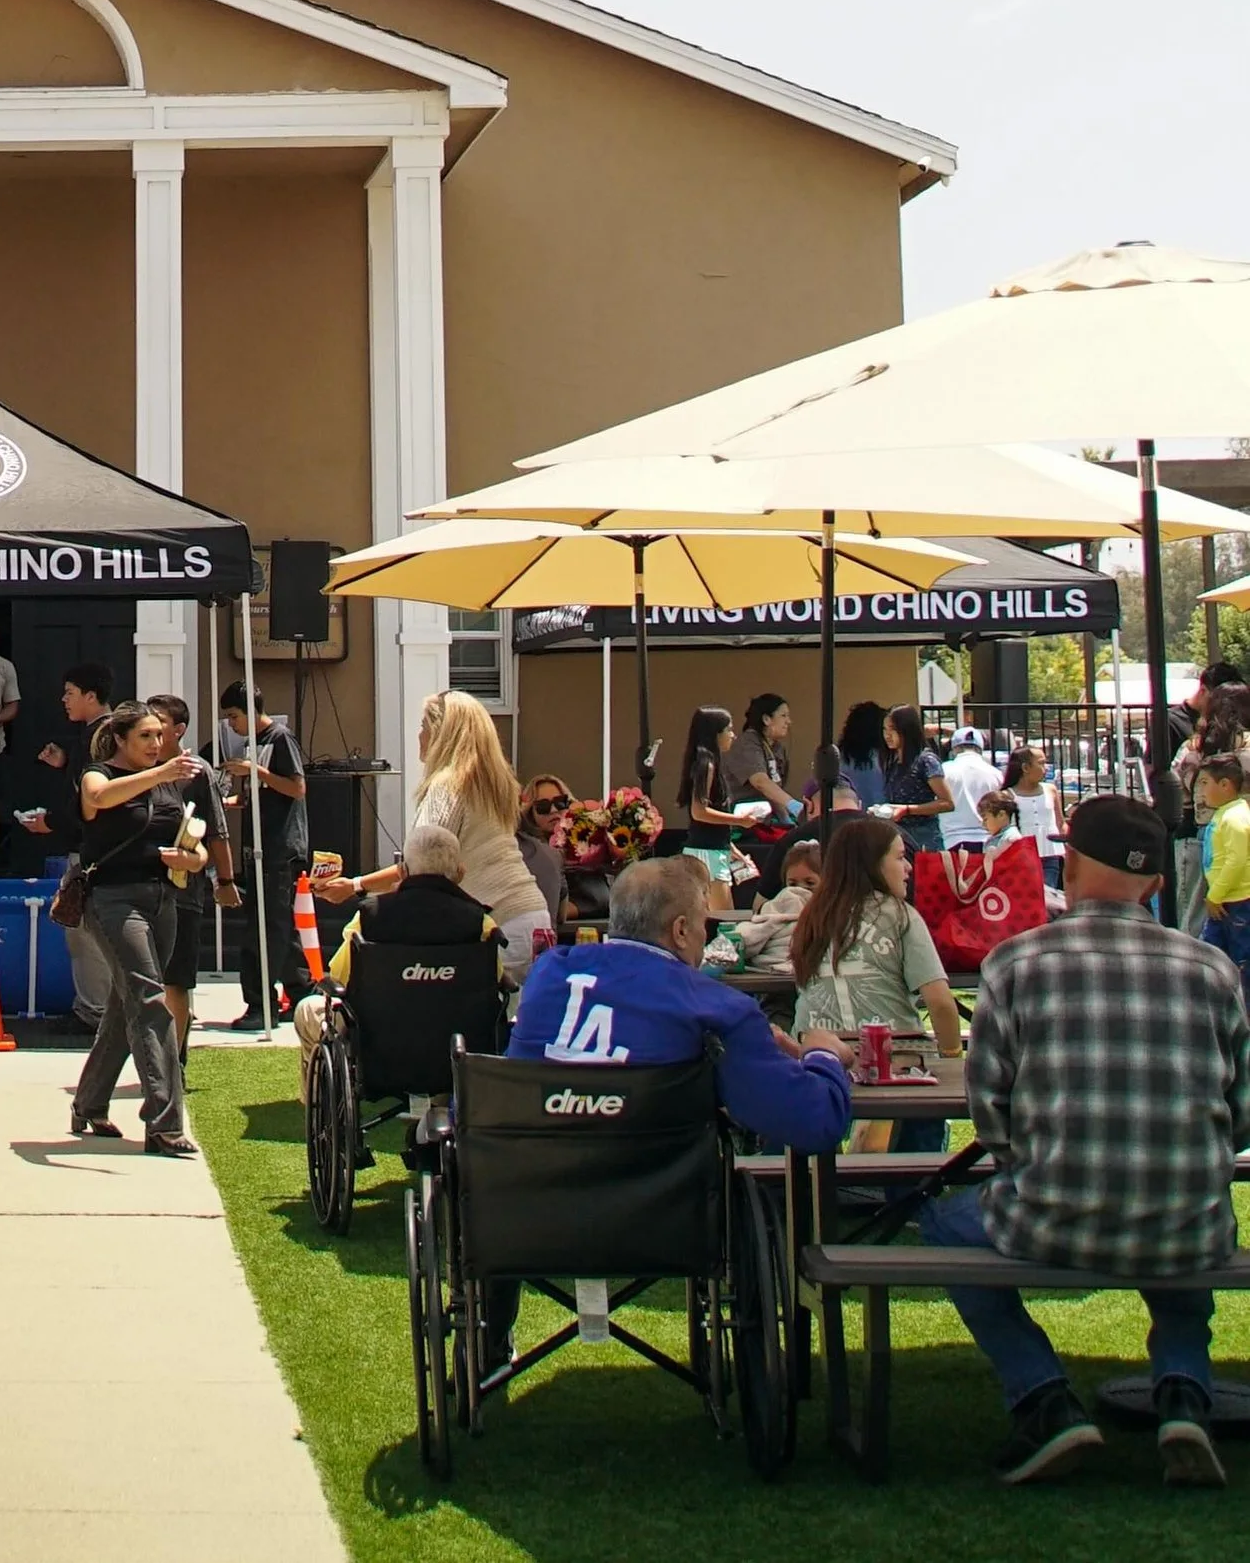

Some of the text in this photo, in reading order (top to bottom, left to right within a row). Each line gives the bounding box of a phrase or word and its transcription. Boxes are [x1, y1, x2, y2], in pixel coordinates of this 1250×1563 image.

[92, 545, 213, 580] HILLS
[870, 590, 983, 622] CHINO
[991, 588, 1089, 619] HILLS
[402, 962, 455, 981] drive
[544, 973, 630, 1064] LA
[545, 1089, 624, 1116] drive
